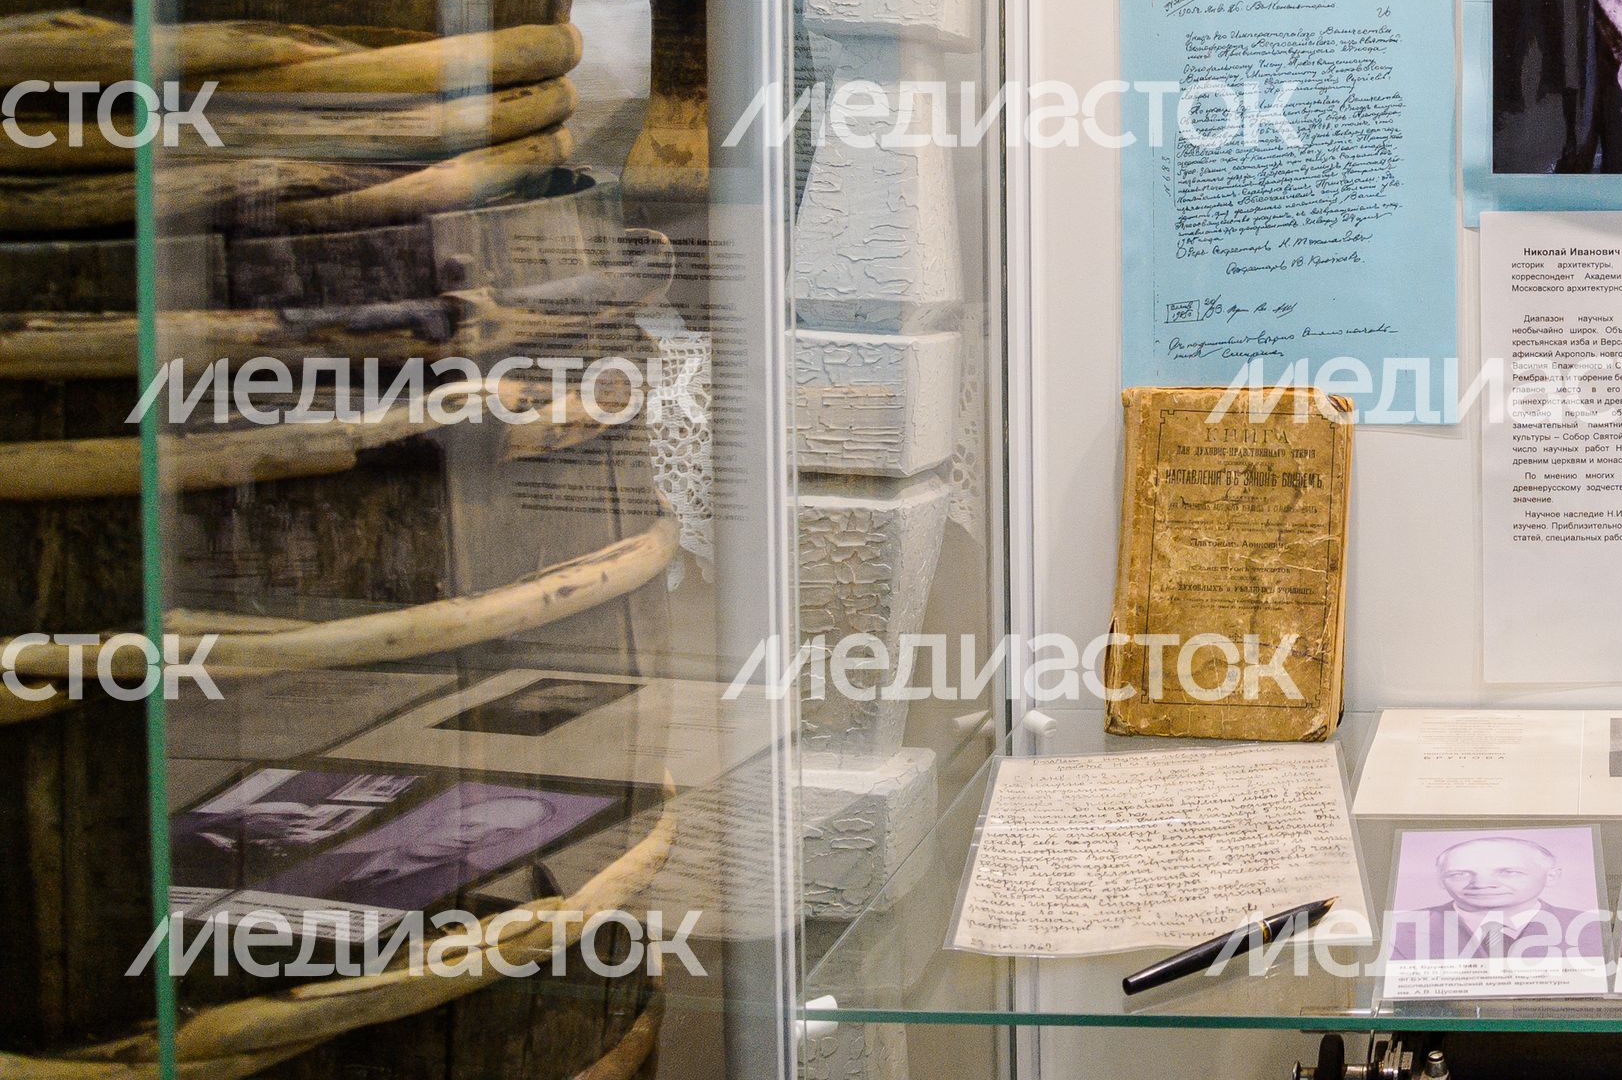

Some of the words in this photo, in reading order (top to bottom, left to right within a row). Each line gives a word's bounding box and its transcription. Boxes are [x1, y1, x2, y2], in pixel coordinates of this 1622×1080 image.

[1523, 247, 1566, 256] Николай
[1569, 247, 1622, 256] Иванович
[1511, 284, 1564, 292] Московского
[1206, 427, 1291, 444] КНИГА
[1524, 510, 1560, 519] Научное
